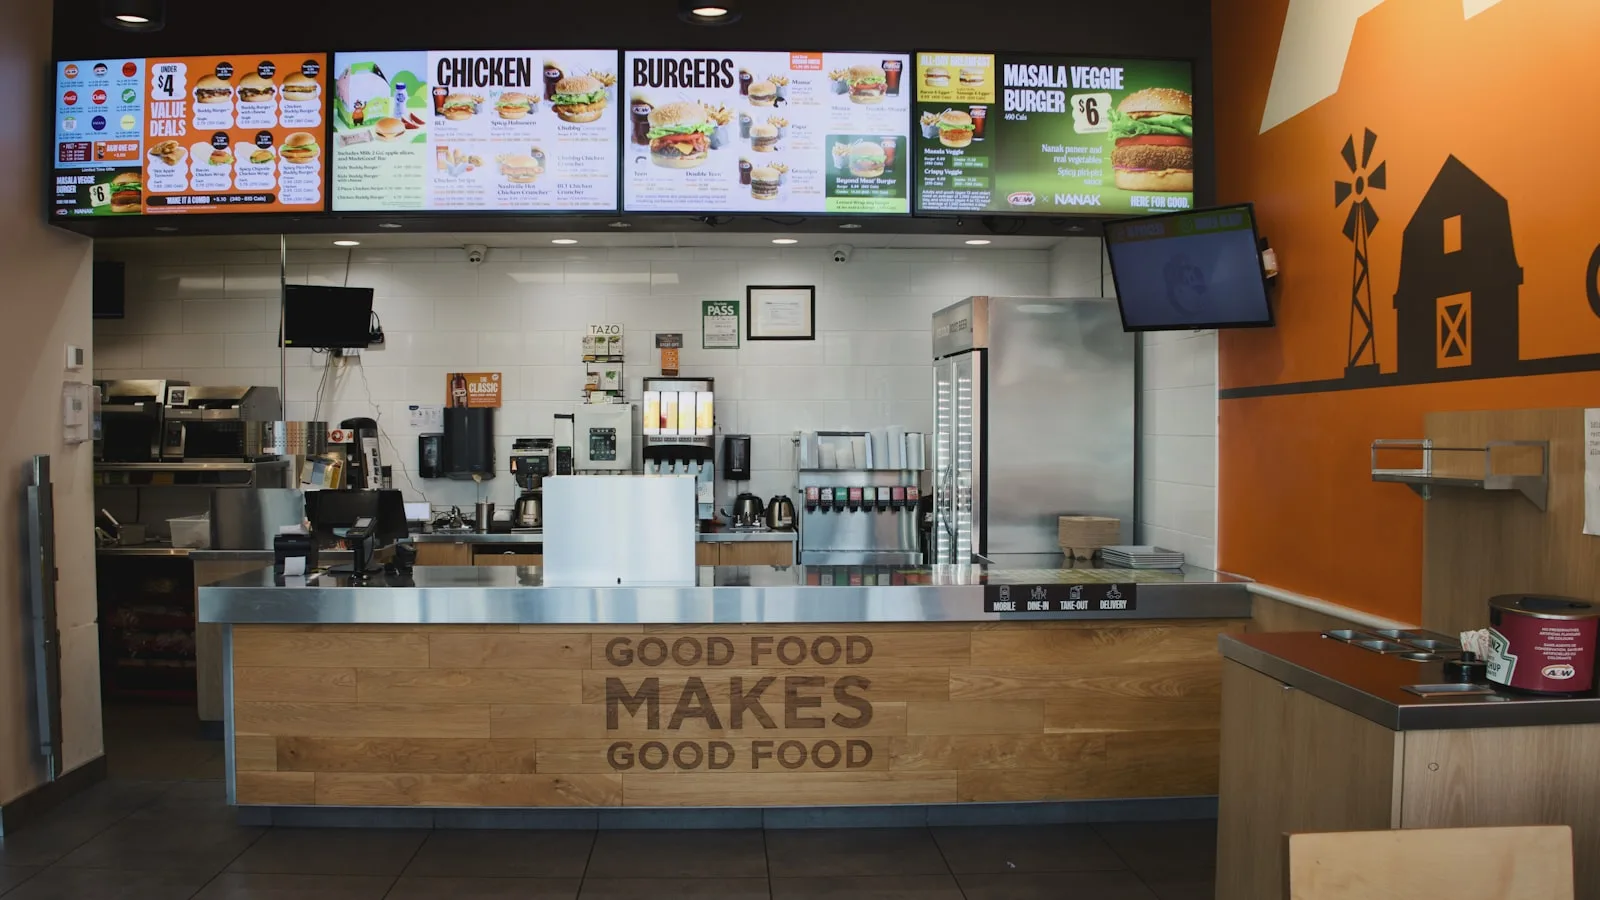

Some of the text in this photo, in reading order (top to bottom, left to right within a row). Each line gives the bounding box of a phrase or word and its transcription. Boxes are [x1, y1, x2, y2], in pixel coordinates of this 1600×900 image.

[437, 57, 531, 88] CHICKEN
[634, 58, 734, 88] BURGERS
[1004, 64, 1124, 90] MASALA VEGGIE
[158, 74, 174, 96] $4
[1004, 88, 1065, 113] BURGER
[150, 101, 186, 119] VALUE
[1078, 98, 1099, 126] $6
[150, 120, 186, 136] DEALS
[1042, 144, 1063, 153] Nanak
[1090, 144, 1102, 153] and
[1068, 156, 1102, 165] vegetables
[1058, 168, 1076, 177] Spicy
[93, 186, 104, 202] $6
[1055, 194, 1100, 206] NANAK
[1131, 196, 1189, 208] HERE FOR GOOD.
[708, 306, 734, 316] PASS
[591, 325, 620, 334] TAZO
[469, 383, 498, 393] CLASSIC
[993, 601, 1016, 611] MOBILE
[1027, 601, 1049, 610] DINE-IN
[1060, 600, 1088, 610] TAKE-OUT
[1100, 600, 1127, 610] DELIVERY
[605, 635, 873, 667] GOOD FOOD
[606, 675, 874, 730] MAKES
[606, 740, 873, 770] GOOD FOOD
